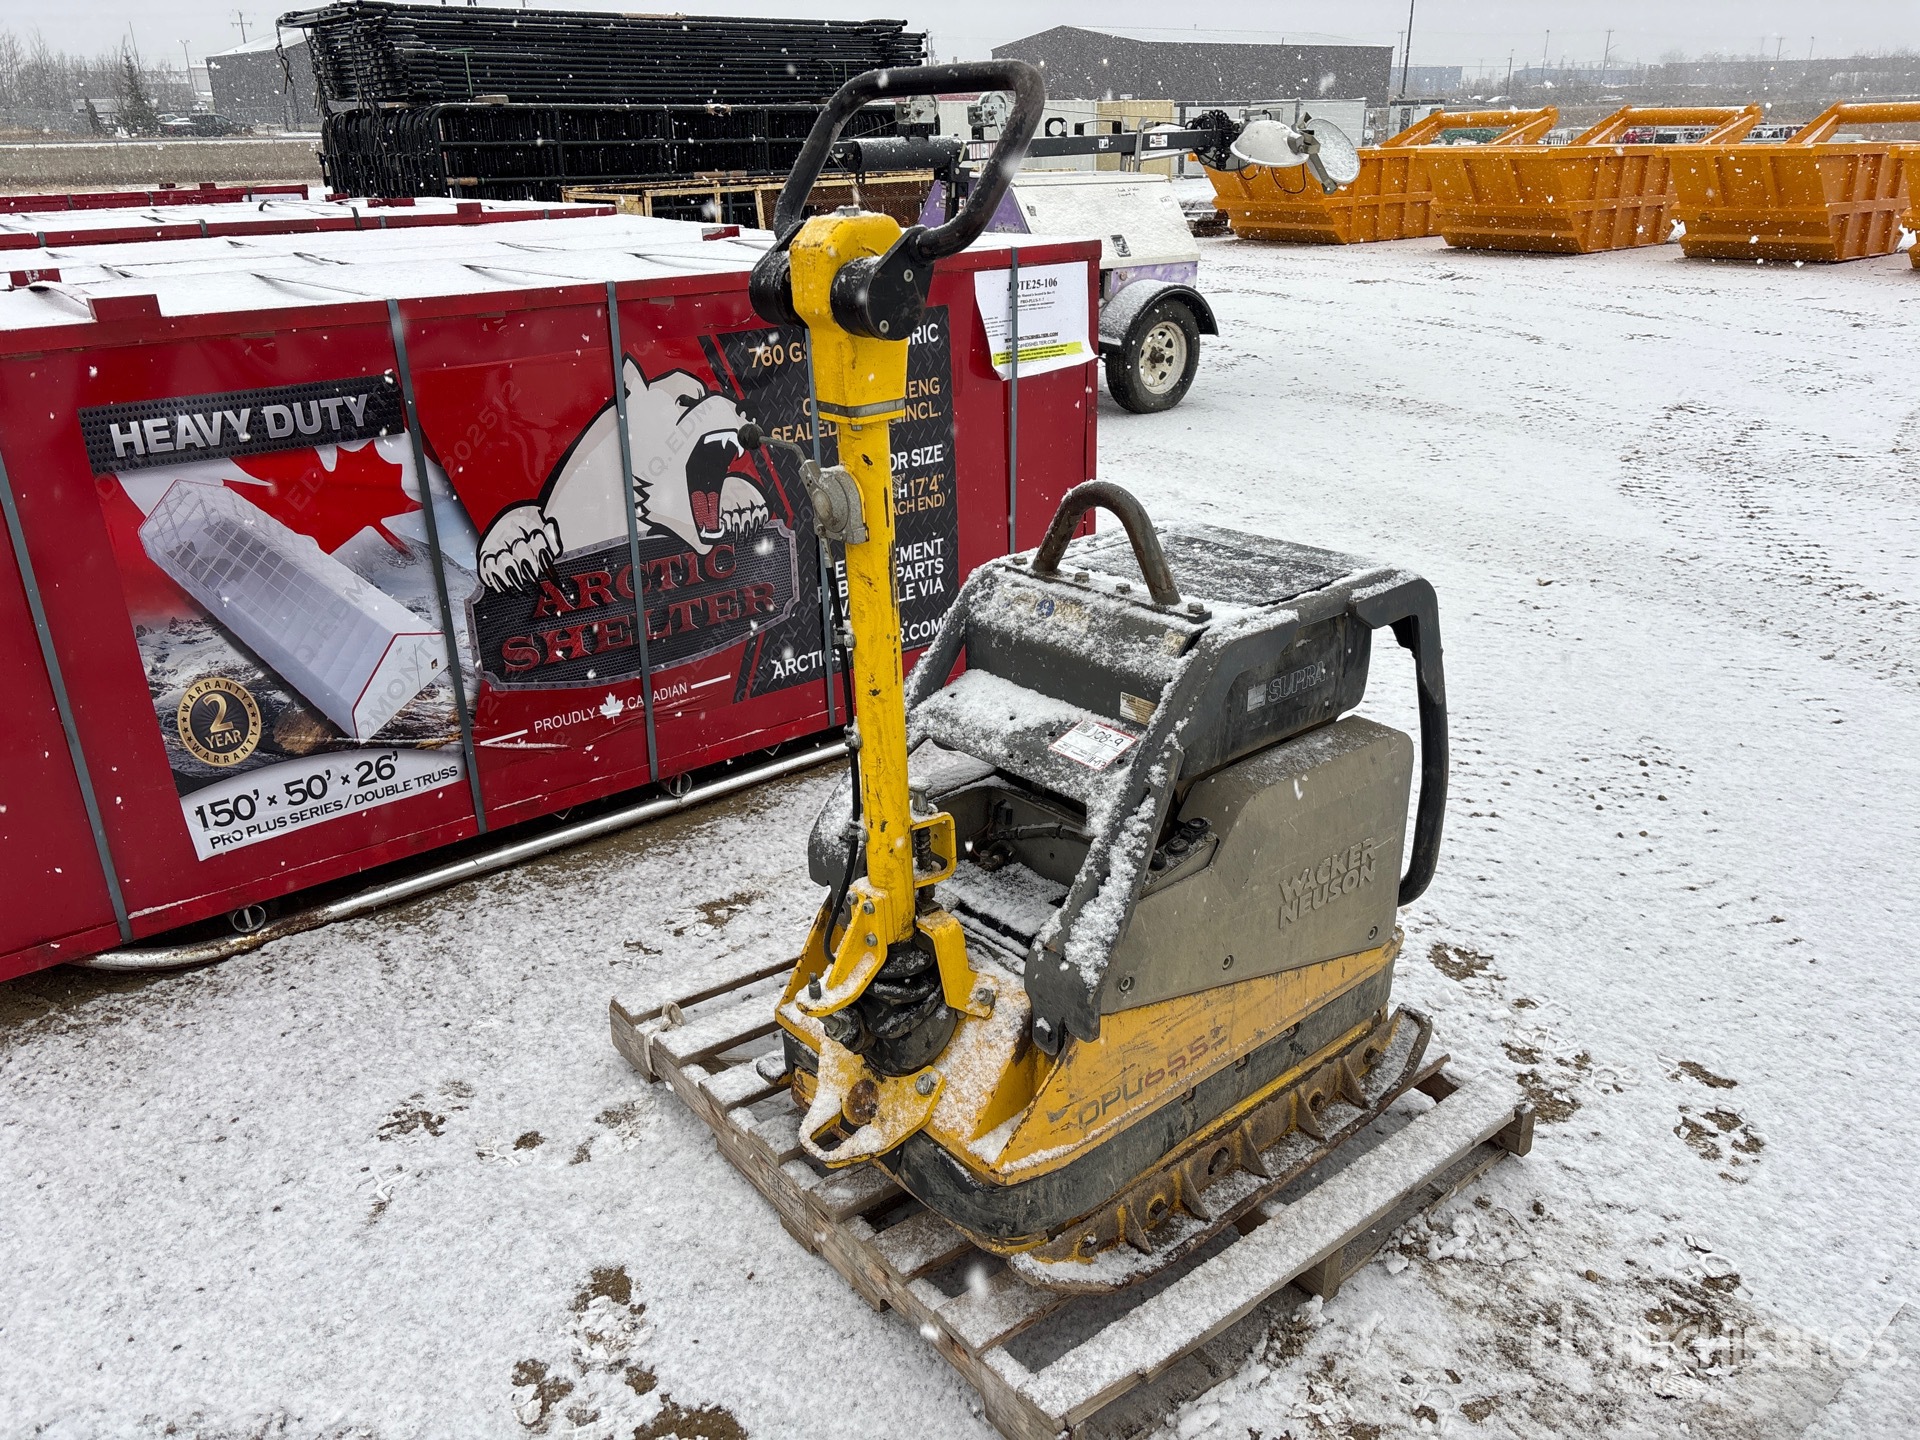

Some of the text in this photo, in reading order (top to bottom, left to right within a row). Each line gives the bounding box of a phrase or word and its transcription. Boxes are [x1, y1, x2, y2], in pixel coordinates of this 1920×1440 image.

[1006, 277, 1058, 292] JTE25-106
[908, 323, 939, 346] RIC
[748, 344, 785, 369] 760
[109, 394, 369, 459] HEAVY DUTY
[911, 443, 944, 468] SIZE
[918, 491, 946, 512] END)
[533, 543, 738, 619] ARCTIC
[896, 558, 944, 582] PARTS
[919, 576, 944, 597] VIA
[500, 581, 780, 674] SHELTER
[182, 680, 248, 713] WARRANTY
[1268, 661, 1326, 703] SUPRA
[202, 693, 234, 733] 2
[533, 681, 689, 734] PROUDLY CAADIAN
[192, 730, 258, 764] WARRANTY
[205, 729, 243, 750] YEAR
[194, 789, 260, 833] 150'
[283, 769, 332, 807] 50'
[355, 750, 399, 789] 26'
[209, 829, 244, 850] PRO
[247, 816, 288, 839] PLUS
[414, 765, 459, 788] TRUSS
[1279, 837, 1376, 903] WACKER
[1279, 860, 1376, 930] NEUSON
